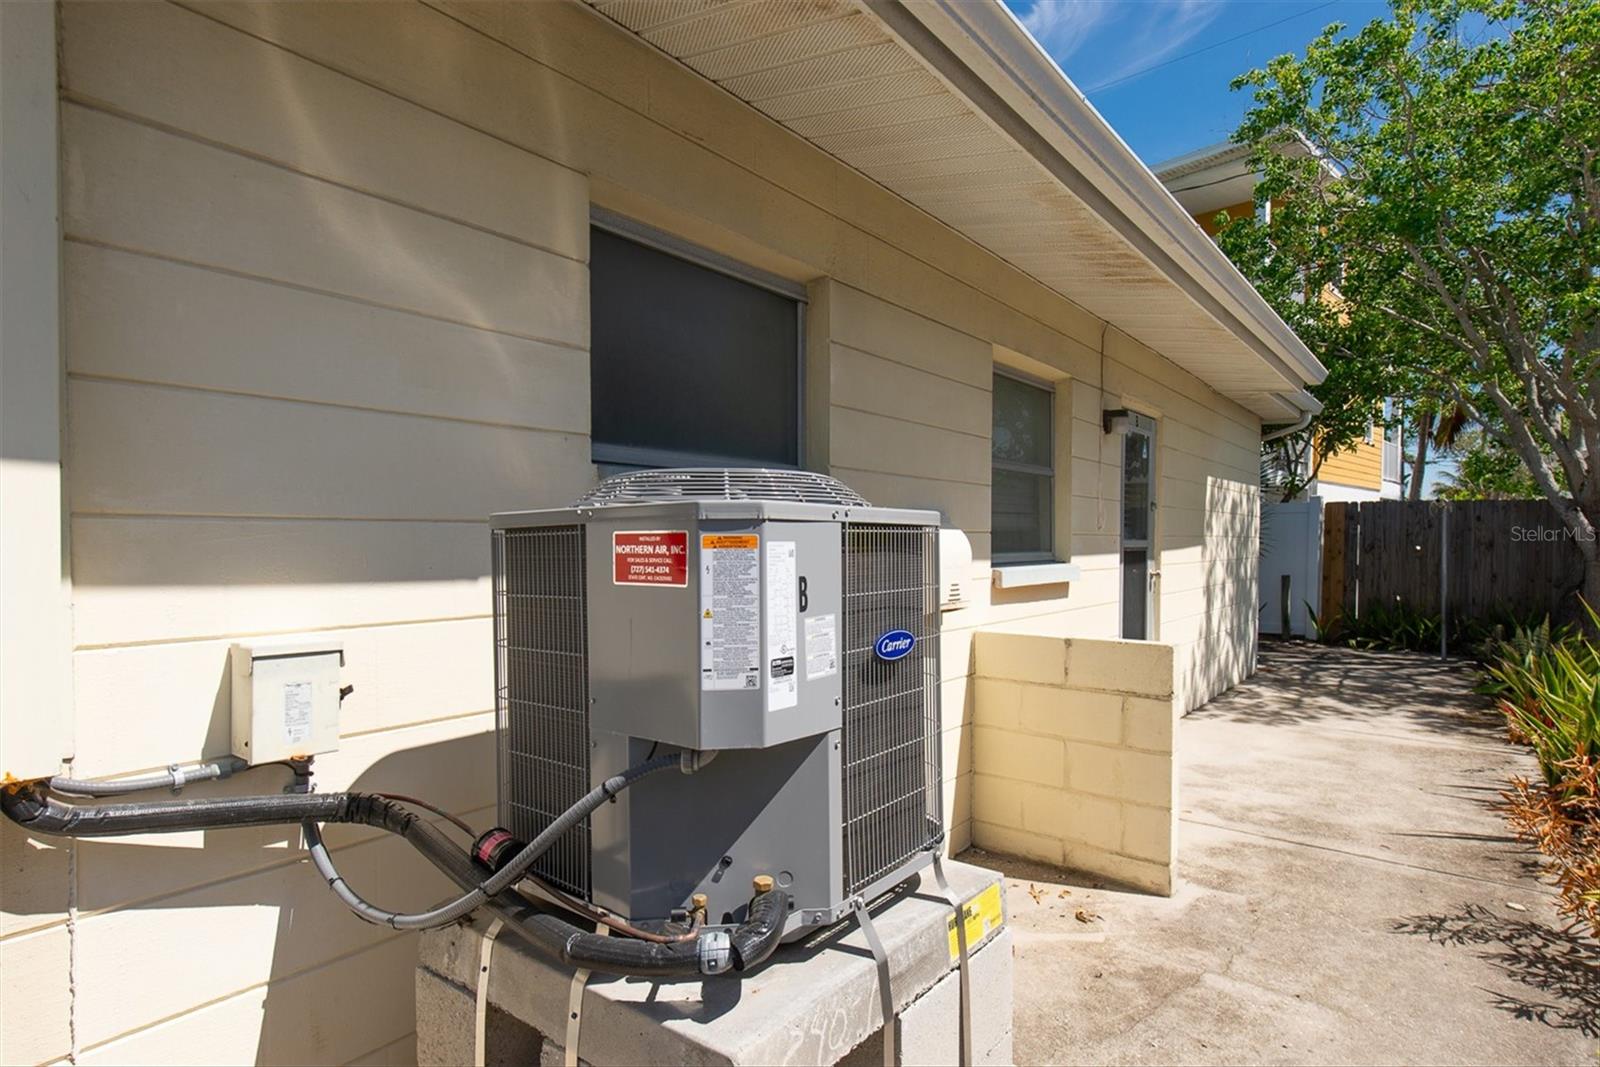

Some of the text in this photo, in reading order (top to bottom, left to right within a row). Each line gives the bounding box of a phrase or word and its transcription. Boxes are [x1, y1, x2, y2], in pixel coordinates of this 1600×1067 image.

[615, 545, 685, 556] NORTHERN AIR, INC.
[798, 575, 808, 613] B
[881, 637, 911, 653] Carrier
